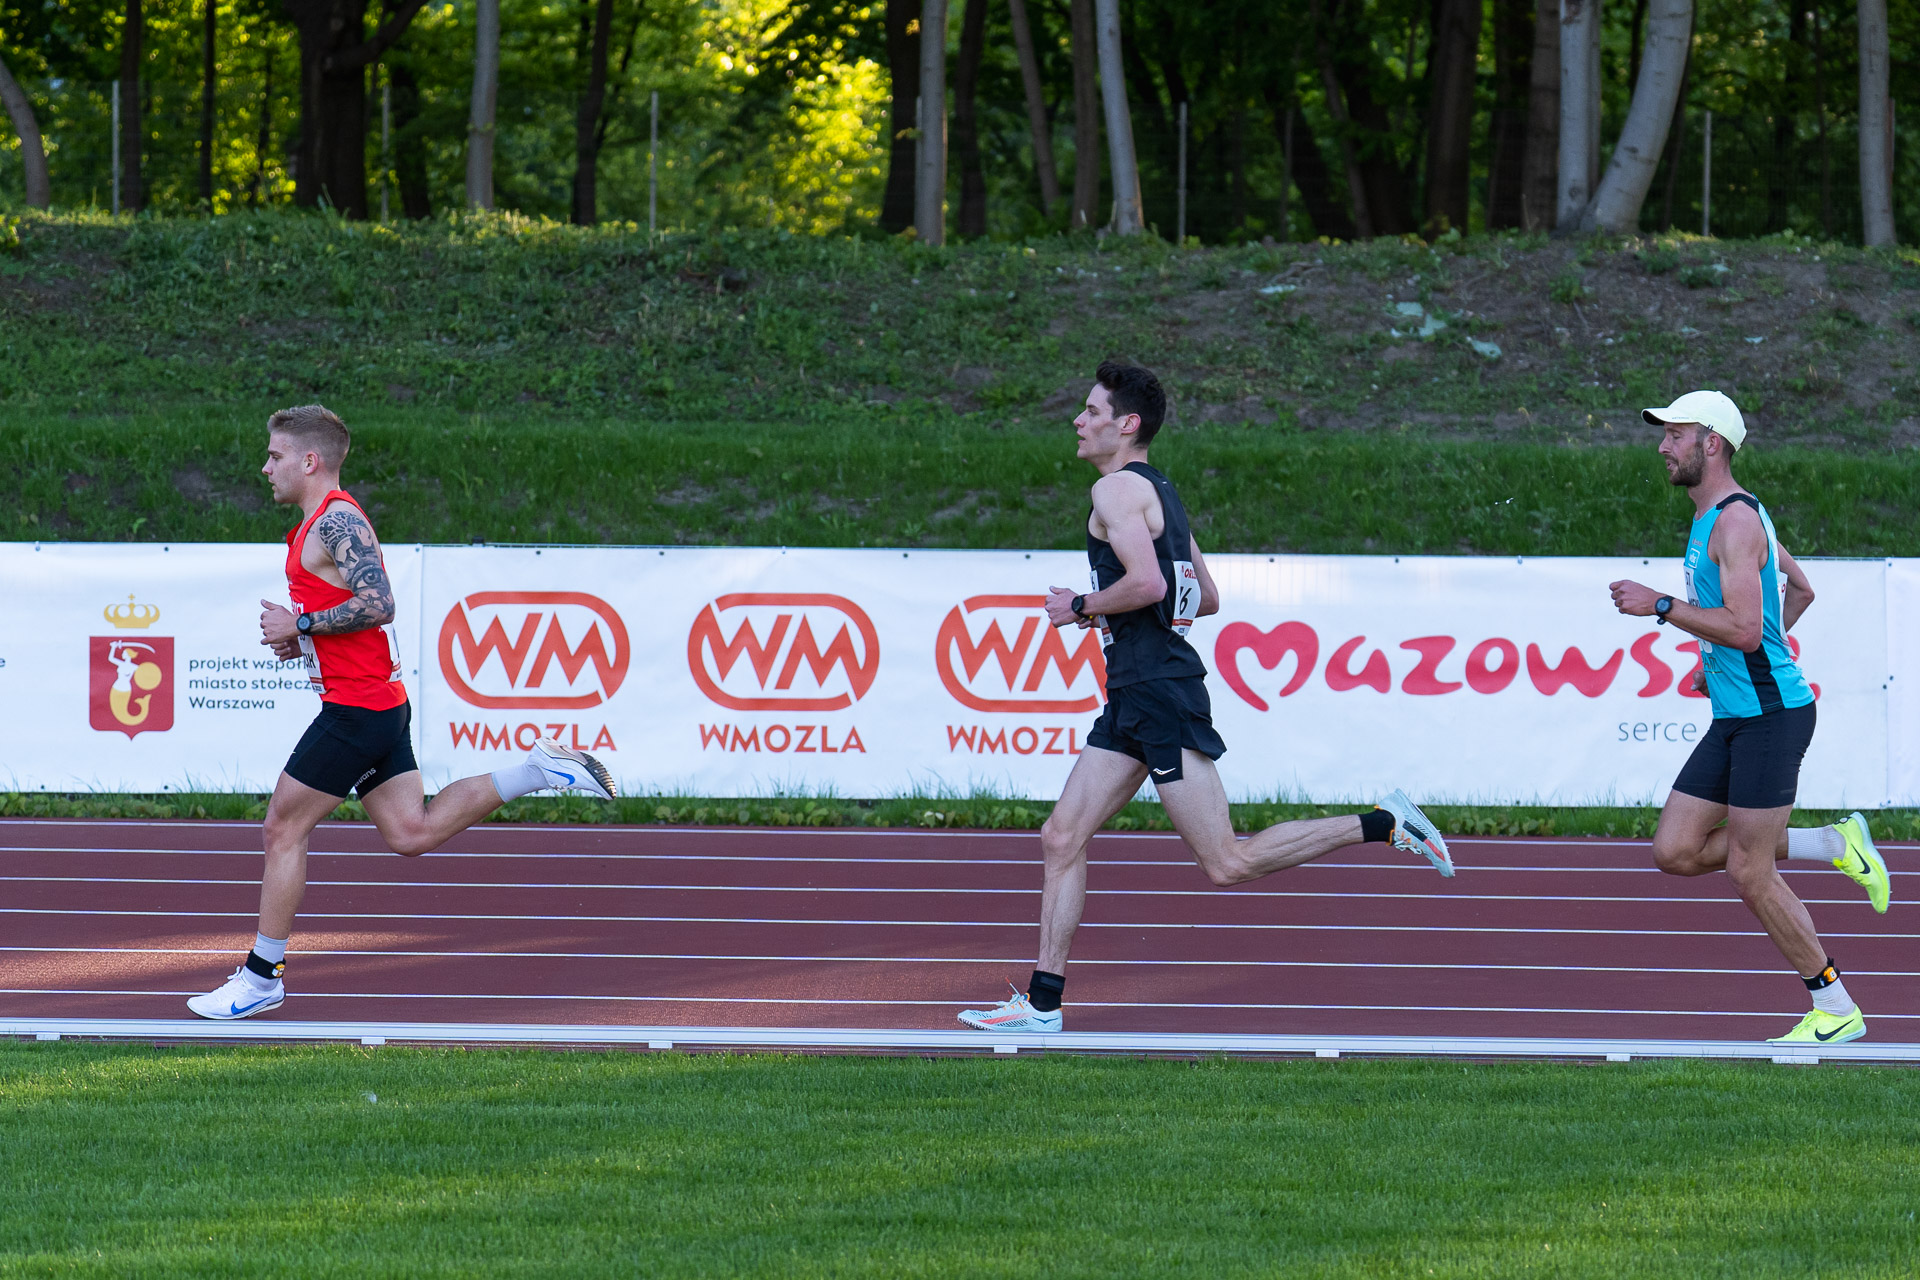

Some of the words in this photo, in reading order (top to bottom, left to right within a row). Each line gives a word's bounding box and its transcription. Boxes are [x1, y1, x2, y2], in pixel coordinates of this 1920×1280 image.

[189, 656, 248, 673] projekt
[252, 656, 307, 673] współ
[1215, 622, 1821, 711] Mazowsz
[189, 676, 247, 689] miasto
[251, 676, 312, 689] stołecz
[189, 696, 275, 709] Warszawa
[449, 722, 617, 752] WMOZLA
[699, 723, 866, 753] WMOZLA
[947, 725, 1083, 755] WMOZL
[1618, 722, 1697, 742] serce
